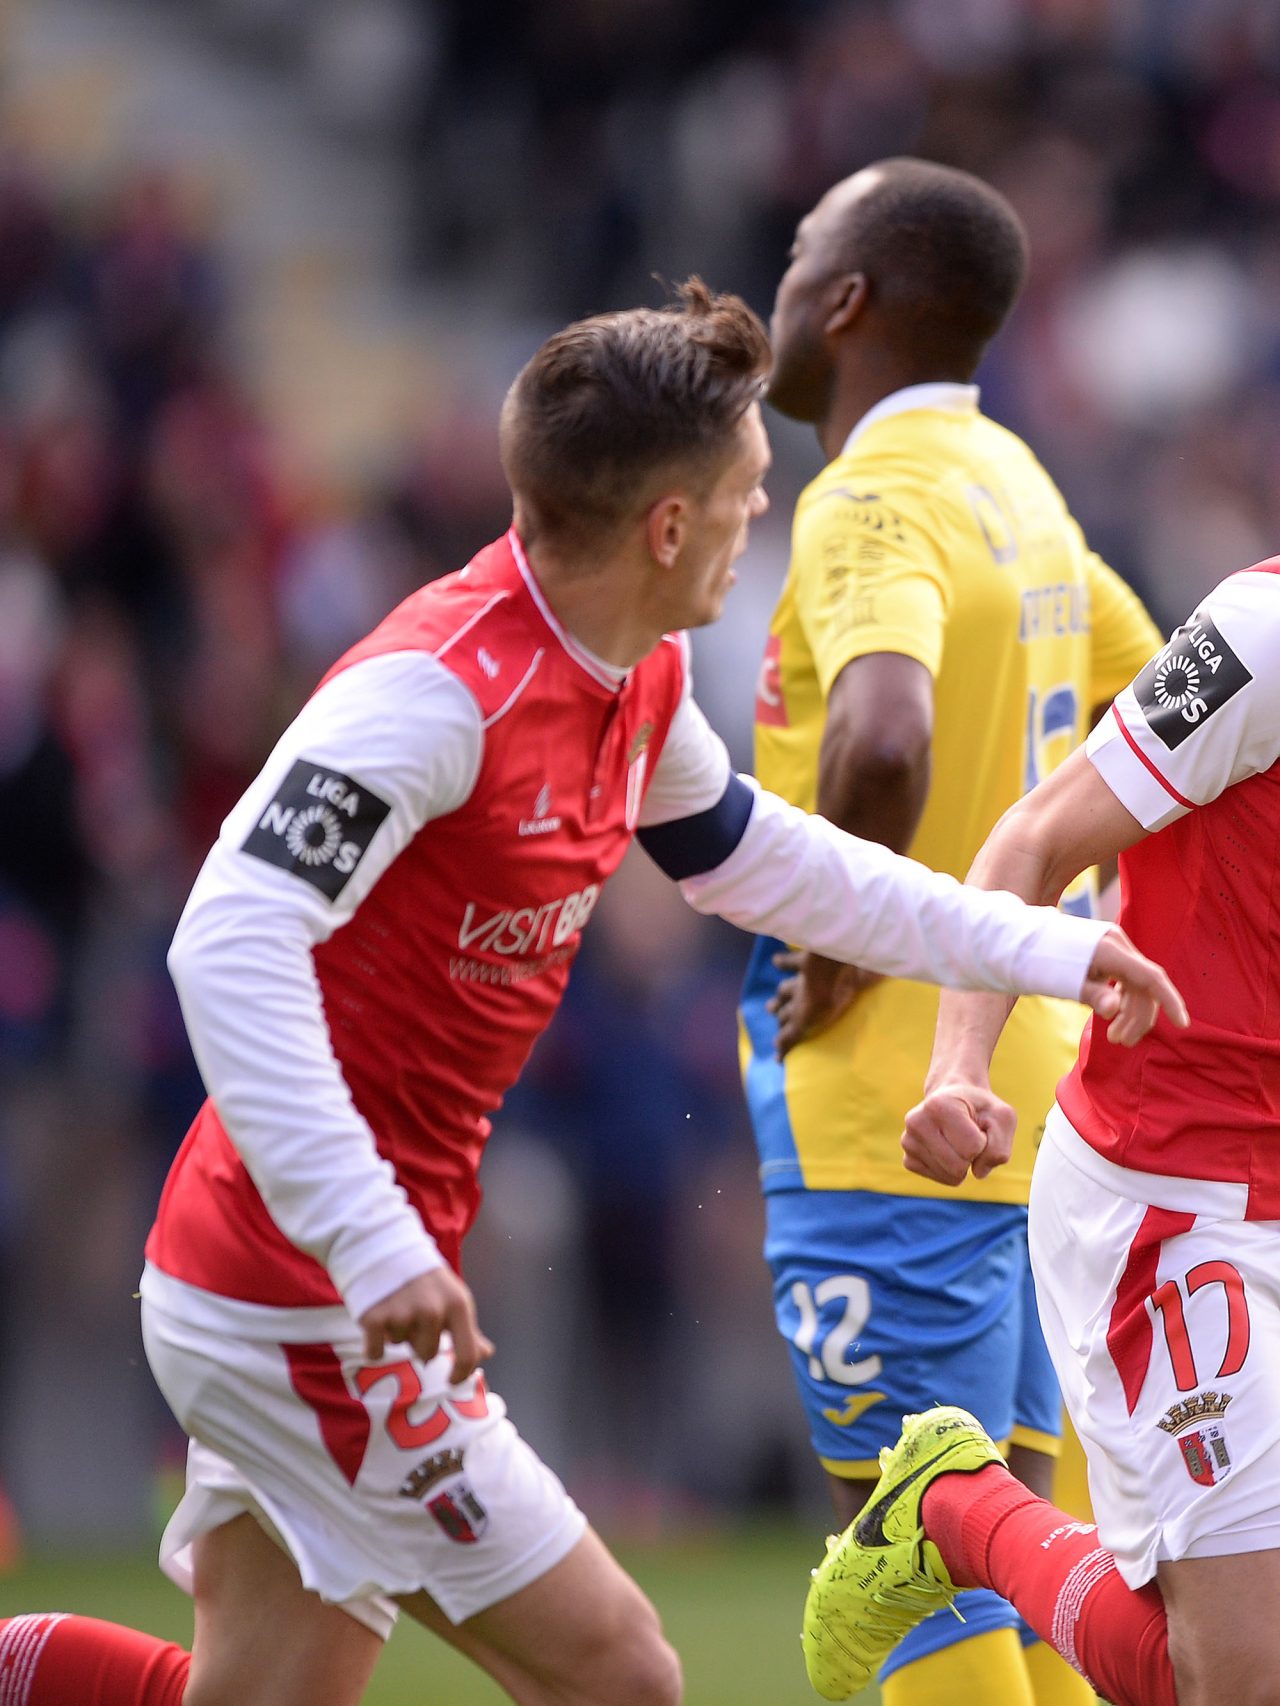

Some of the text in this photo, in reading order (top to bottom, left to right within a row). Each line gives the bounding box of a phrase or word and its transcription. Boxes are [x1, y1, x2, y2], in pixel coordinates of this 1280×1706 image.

[1188, 624, 1223, 675] LIGA
[306, 773, 360, 818] LIGA
[258, 801, 363, 874] NOS
[791, 1274, 883, 1386] 12
[1150, 1260, 1251, 1392] 17
